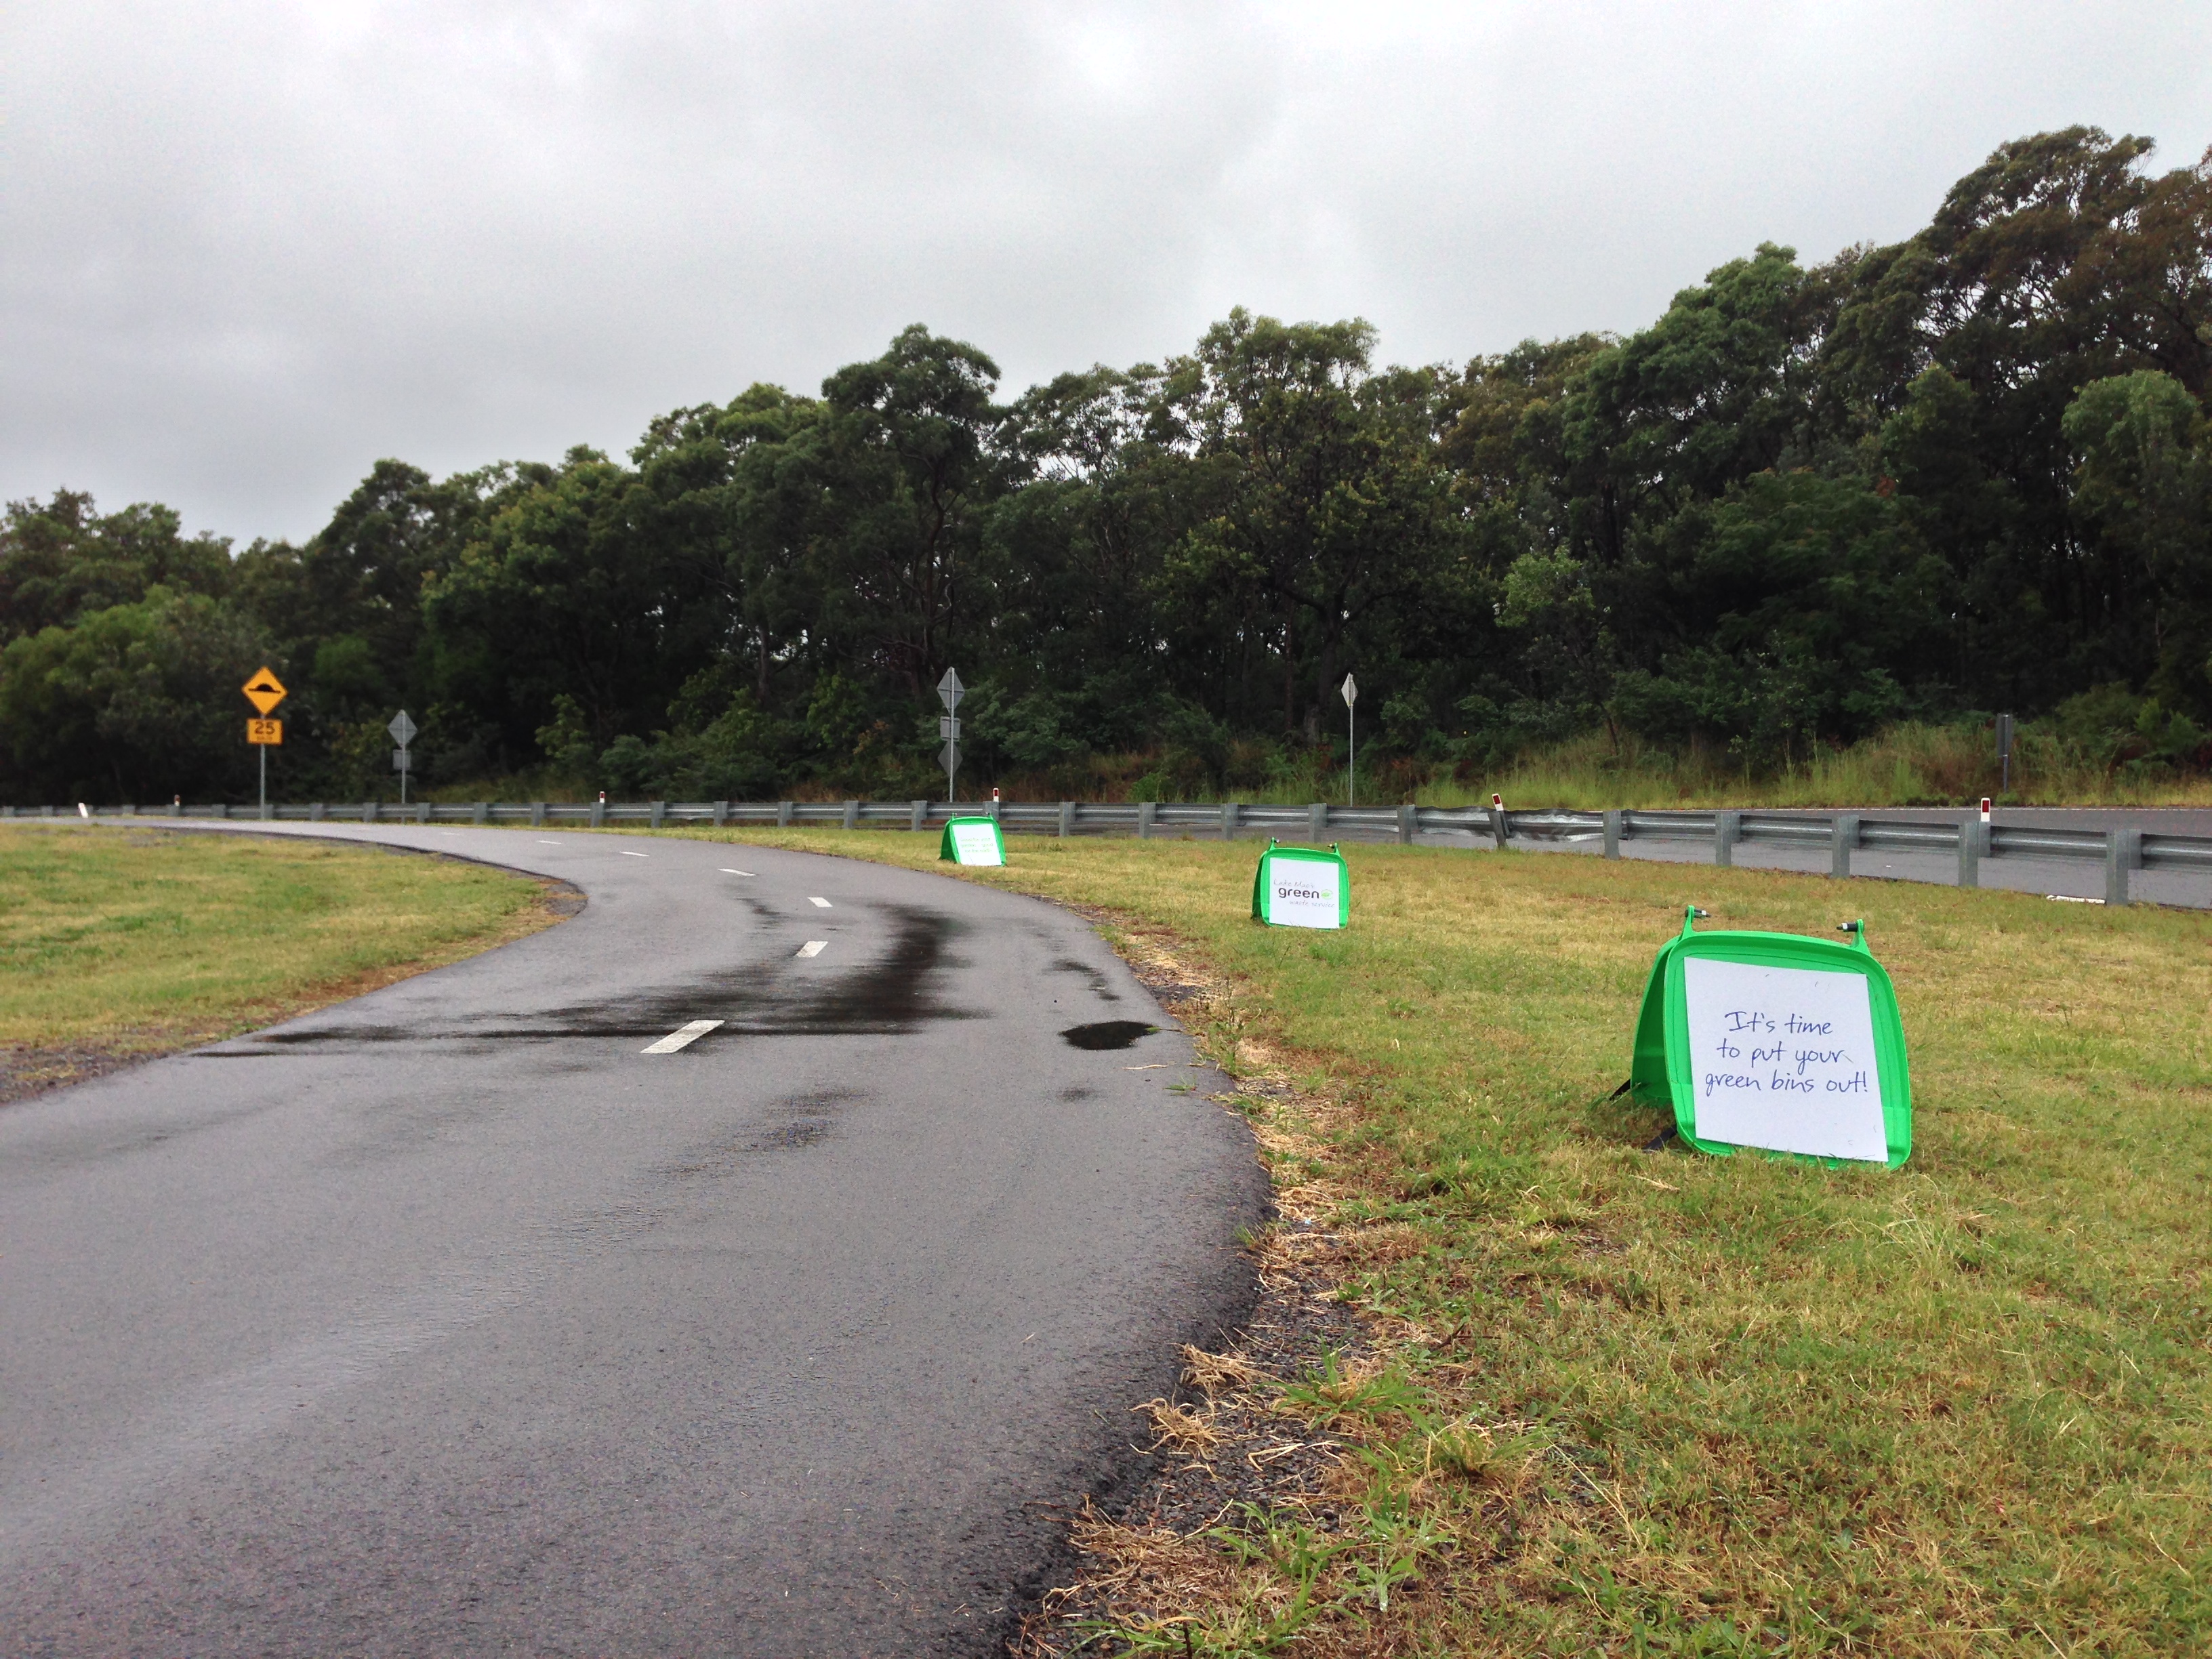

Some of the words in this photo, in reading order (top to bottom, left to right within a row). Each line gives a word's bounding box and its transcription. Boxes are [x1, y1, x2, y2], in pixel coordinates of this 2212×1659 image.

[254, 721, 276, 735] 25
[1278, 887, 1319, 899] green
[1724, 1011, 1776, 1033] It's
[1784, 1013, 1833, 1035] time
[1717, 1038, 1740, 1059] to
[1751, 1040, 1787, 1068] put
[1795, 1050, 1845, 1076] your
[1705, 1072, 1762, 1097] green
[1771, 1069, 1815, 1093] bins
[1826, 1071, 1868, 1092] out!
